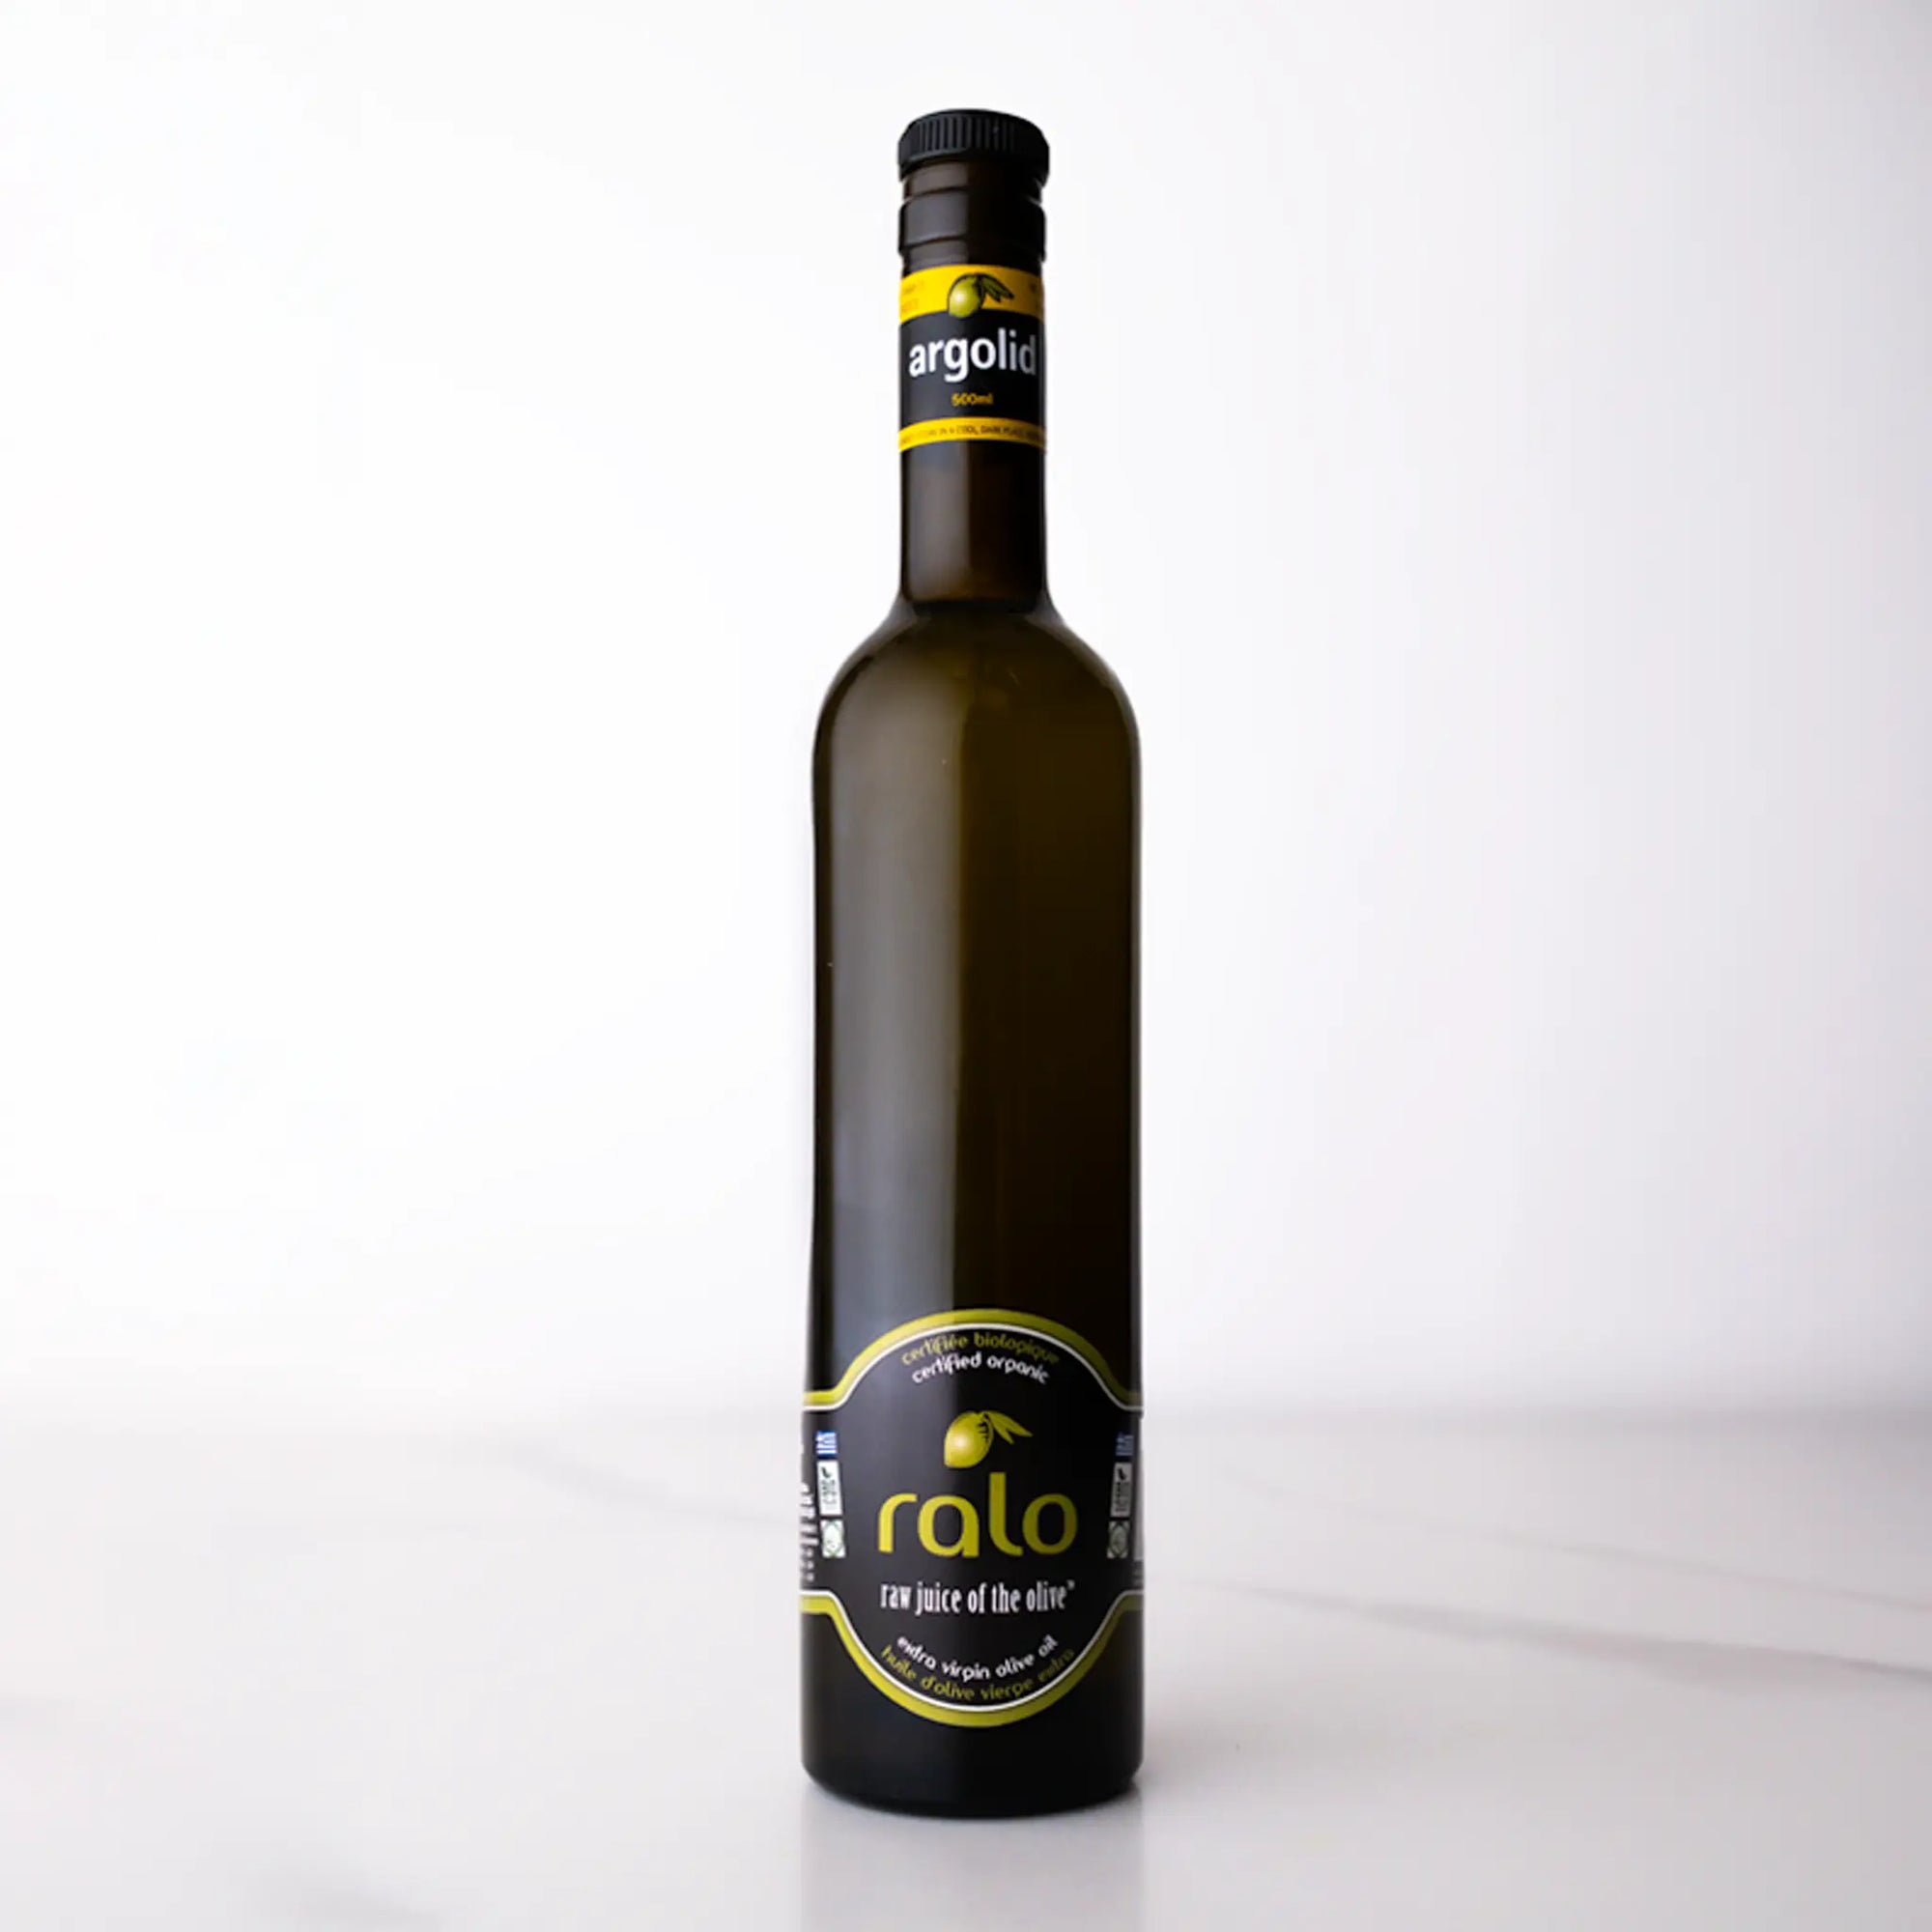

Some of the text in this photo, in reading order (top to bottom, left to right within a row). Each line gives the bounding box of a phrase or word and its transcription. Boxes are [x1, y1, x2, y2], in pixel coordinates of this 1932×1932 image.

[909, 327, 1037, 383] argolid
[911, 1351, 982, 1383] certified
[878, 1472, 1078, 1558] ralo
[880, 1582, 912, 1609] raw
[915, 1580, 962, 1616] juice
[967, 1582, 987, 1613] of
[991, 1582, 1021, 1613] the
[881, 1644, 917, 1681] huile
[896, 1636, 937, 1670] extra
[995, 1653, 1036, 1678] olive
[1037, 1634, 1059, 1658] oil
